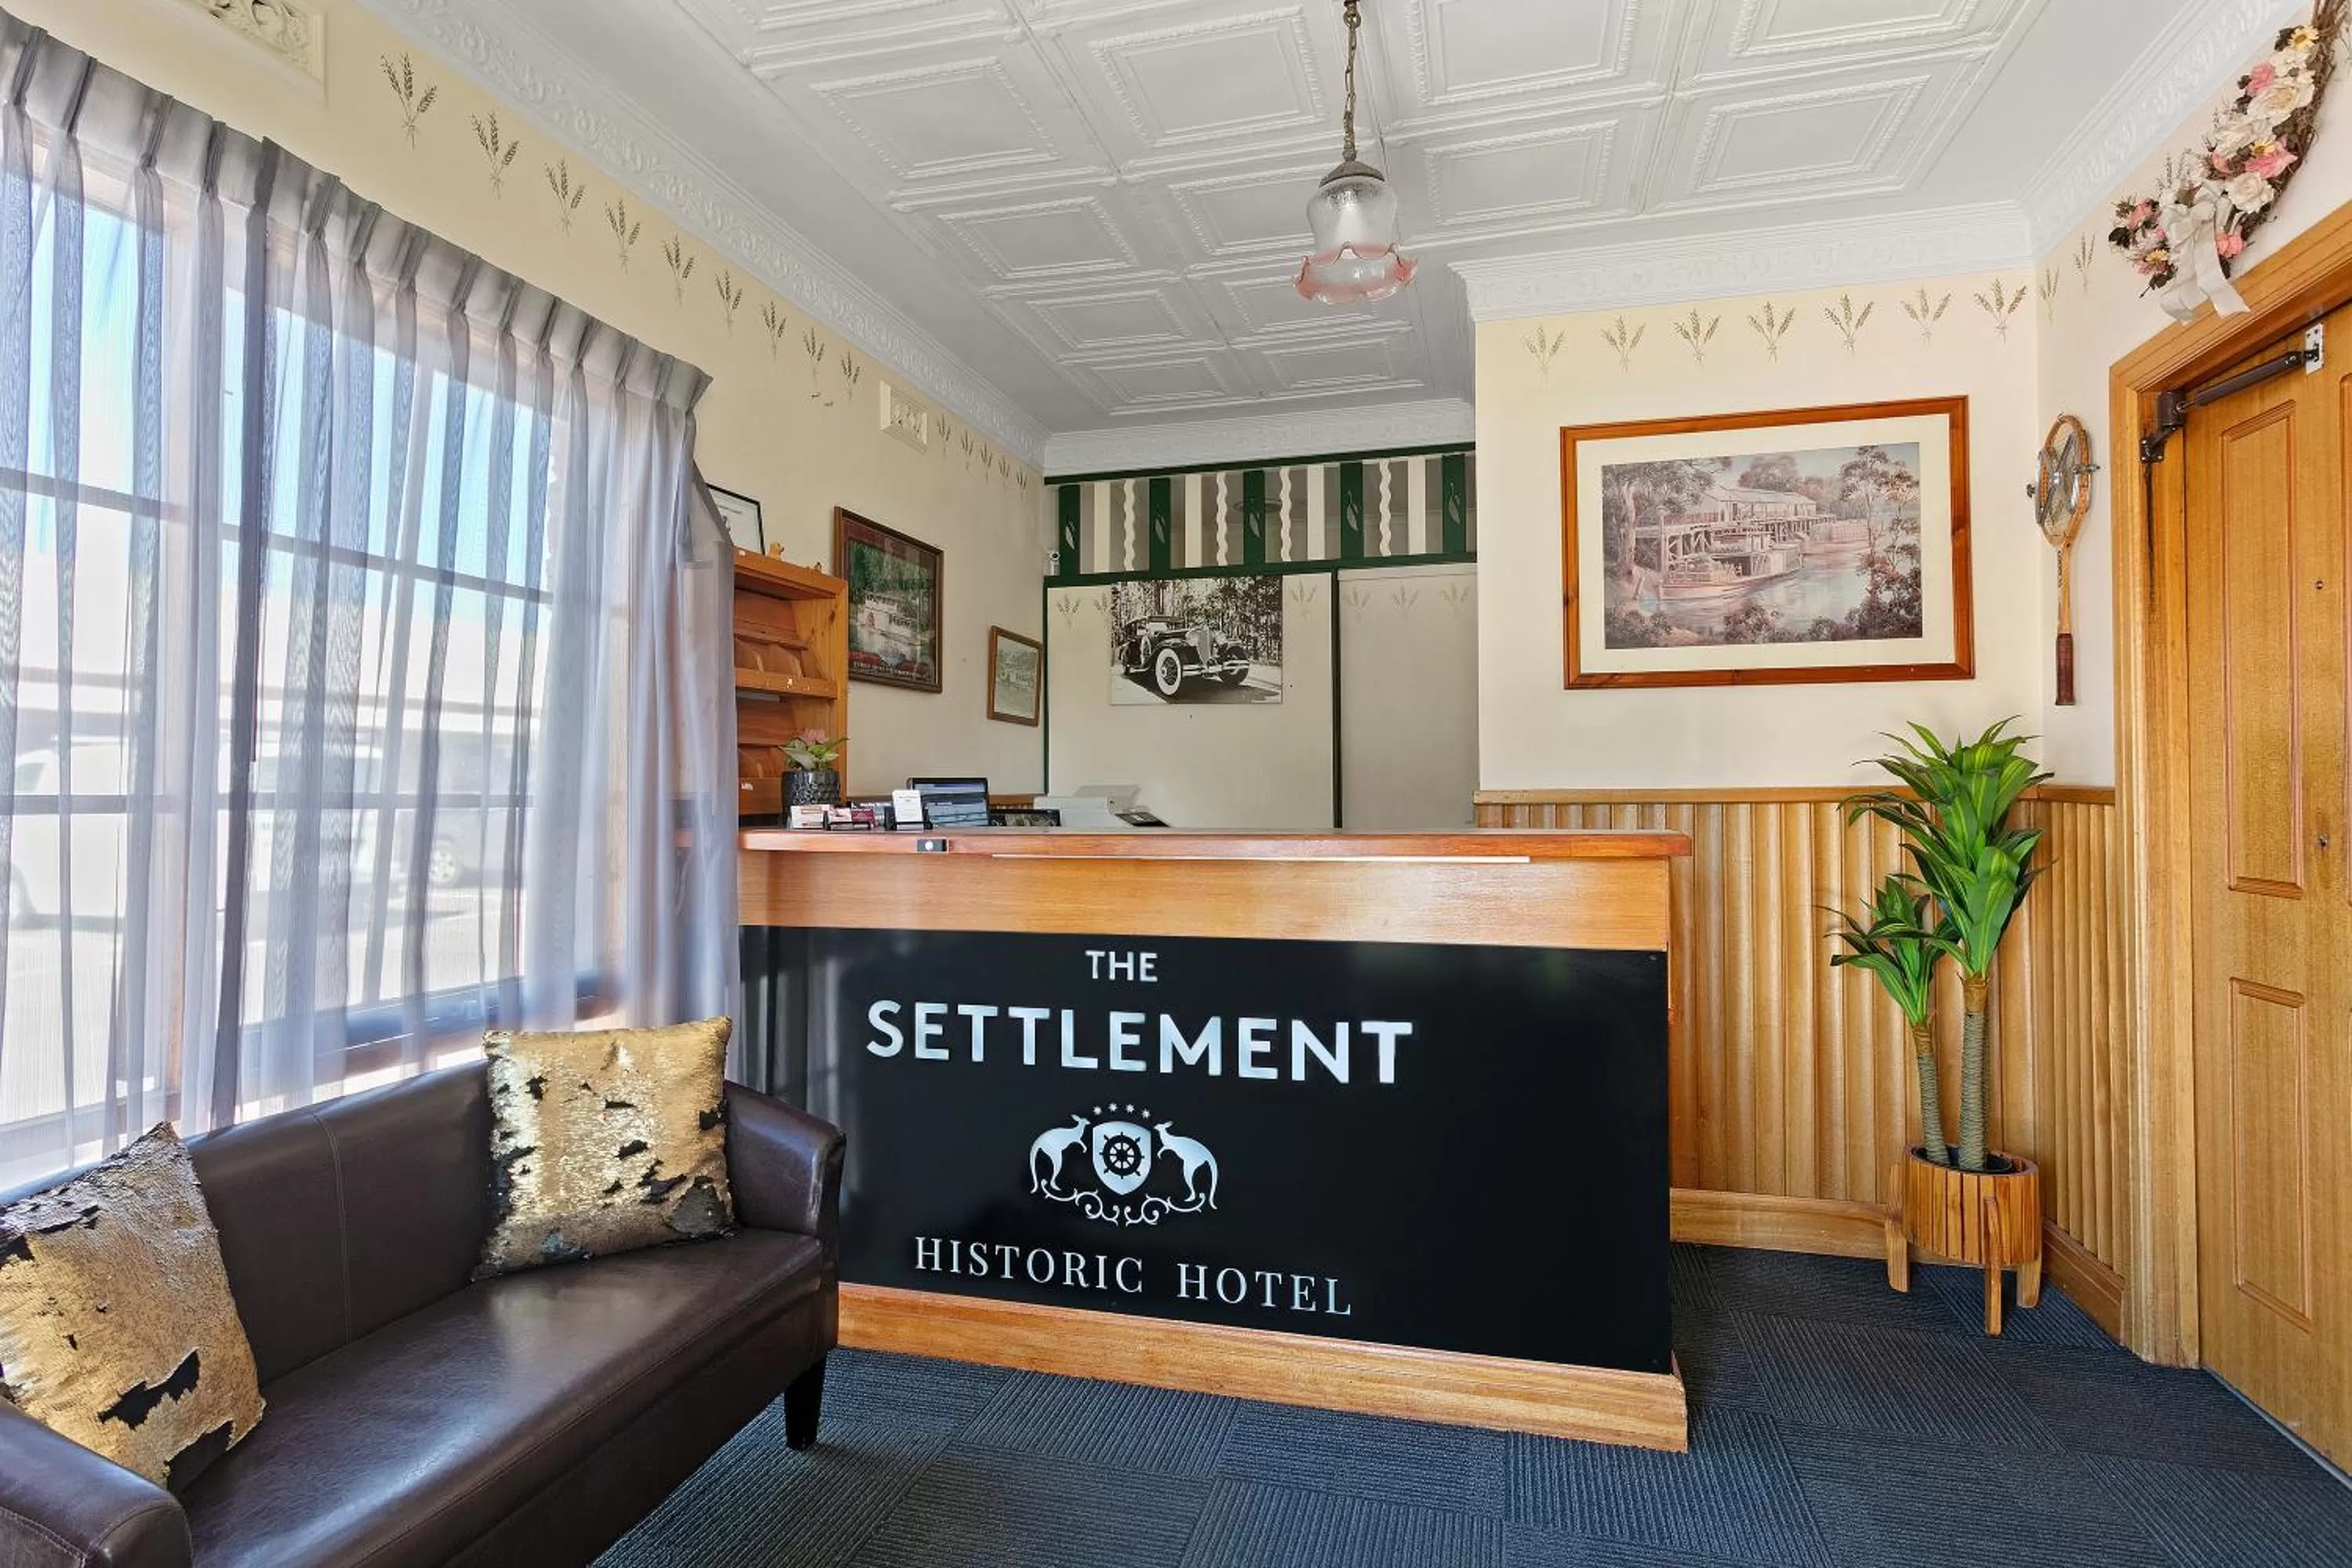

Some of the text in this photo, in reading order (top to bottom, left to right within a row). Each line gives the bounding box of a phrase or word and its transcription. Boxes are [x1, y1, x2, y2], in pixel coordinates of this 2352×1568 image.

[1085, 949, 1158, 982] THE
[866, 1000, 1413, 1084] SETTLEMENT
[915, 1236, 1352, 1316] HISTORIC HOTEL
